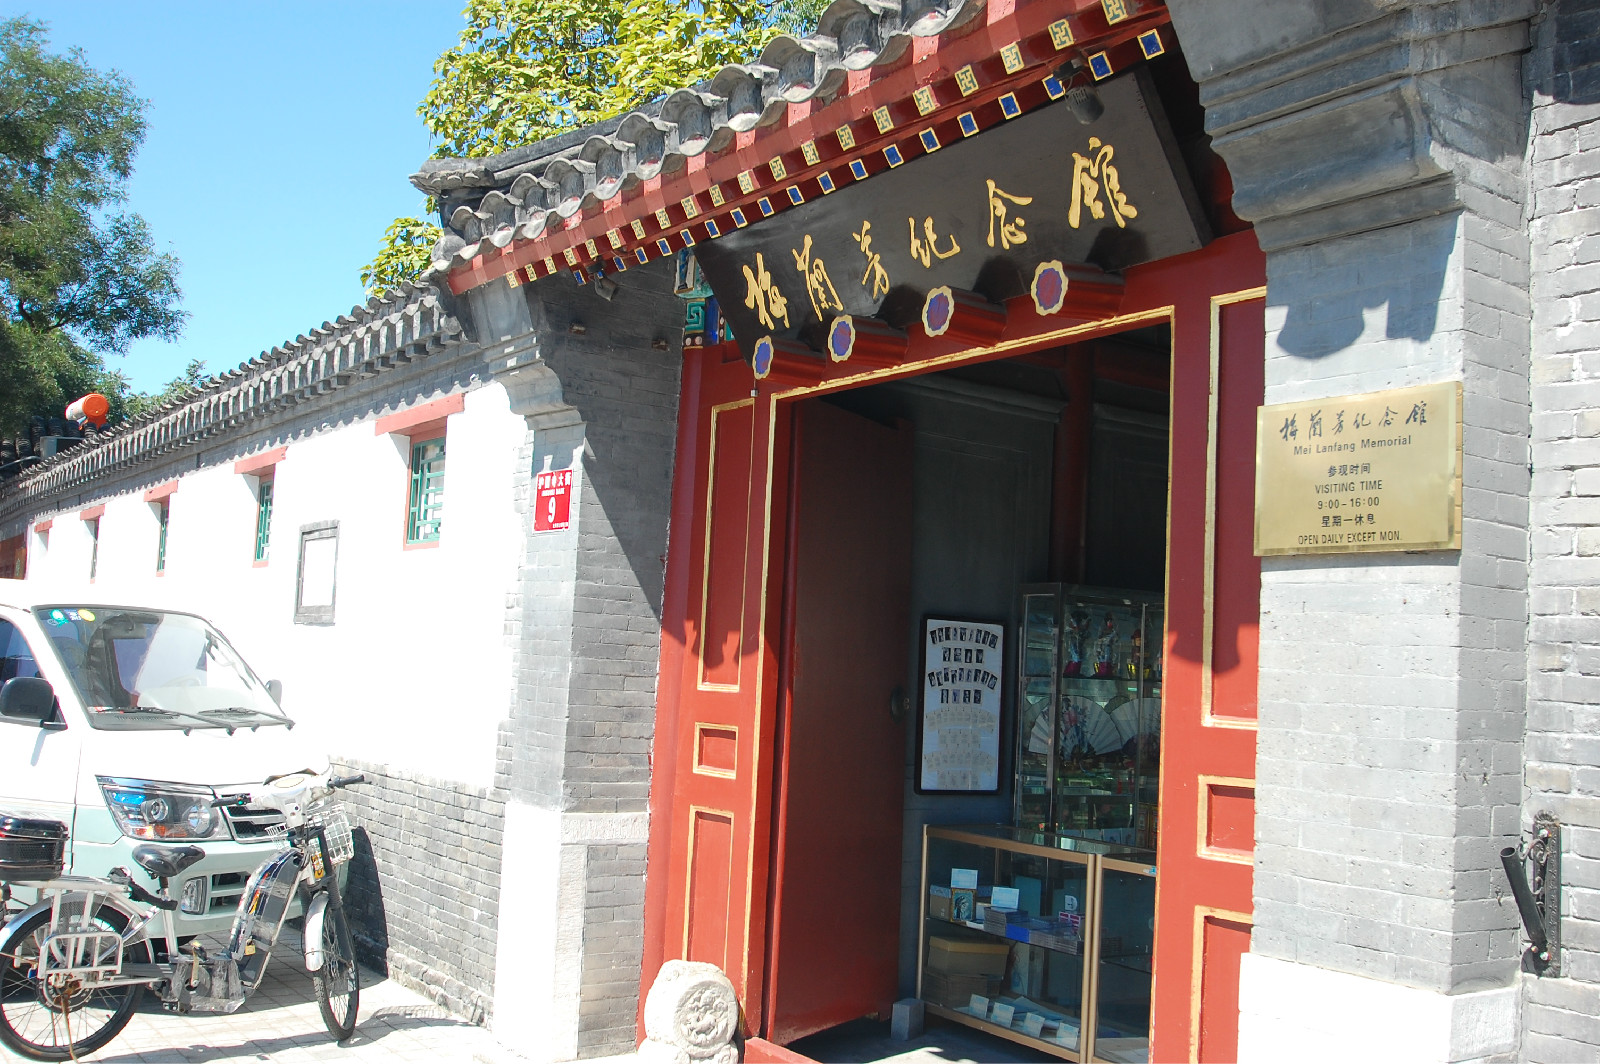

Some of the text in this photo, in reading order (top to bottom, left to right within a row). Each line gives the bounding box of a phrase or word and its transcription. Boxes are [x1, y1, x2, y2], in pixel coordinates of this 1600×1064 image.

[1293, 434, 1411, 456] Mei Lanfang Memorial
[1315, 479, 1383, 494] VISITING TIME
[548, 497, 556, 523] 9
[1321, 513, 1376, 528] 星期一休息
[1298, 534, 1319, 545] OPEN
[1321, 533, 1344, 544] DAILY
[1347, 531, 1377, 543] EXCEPT
